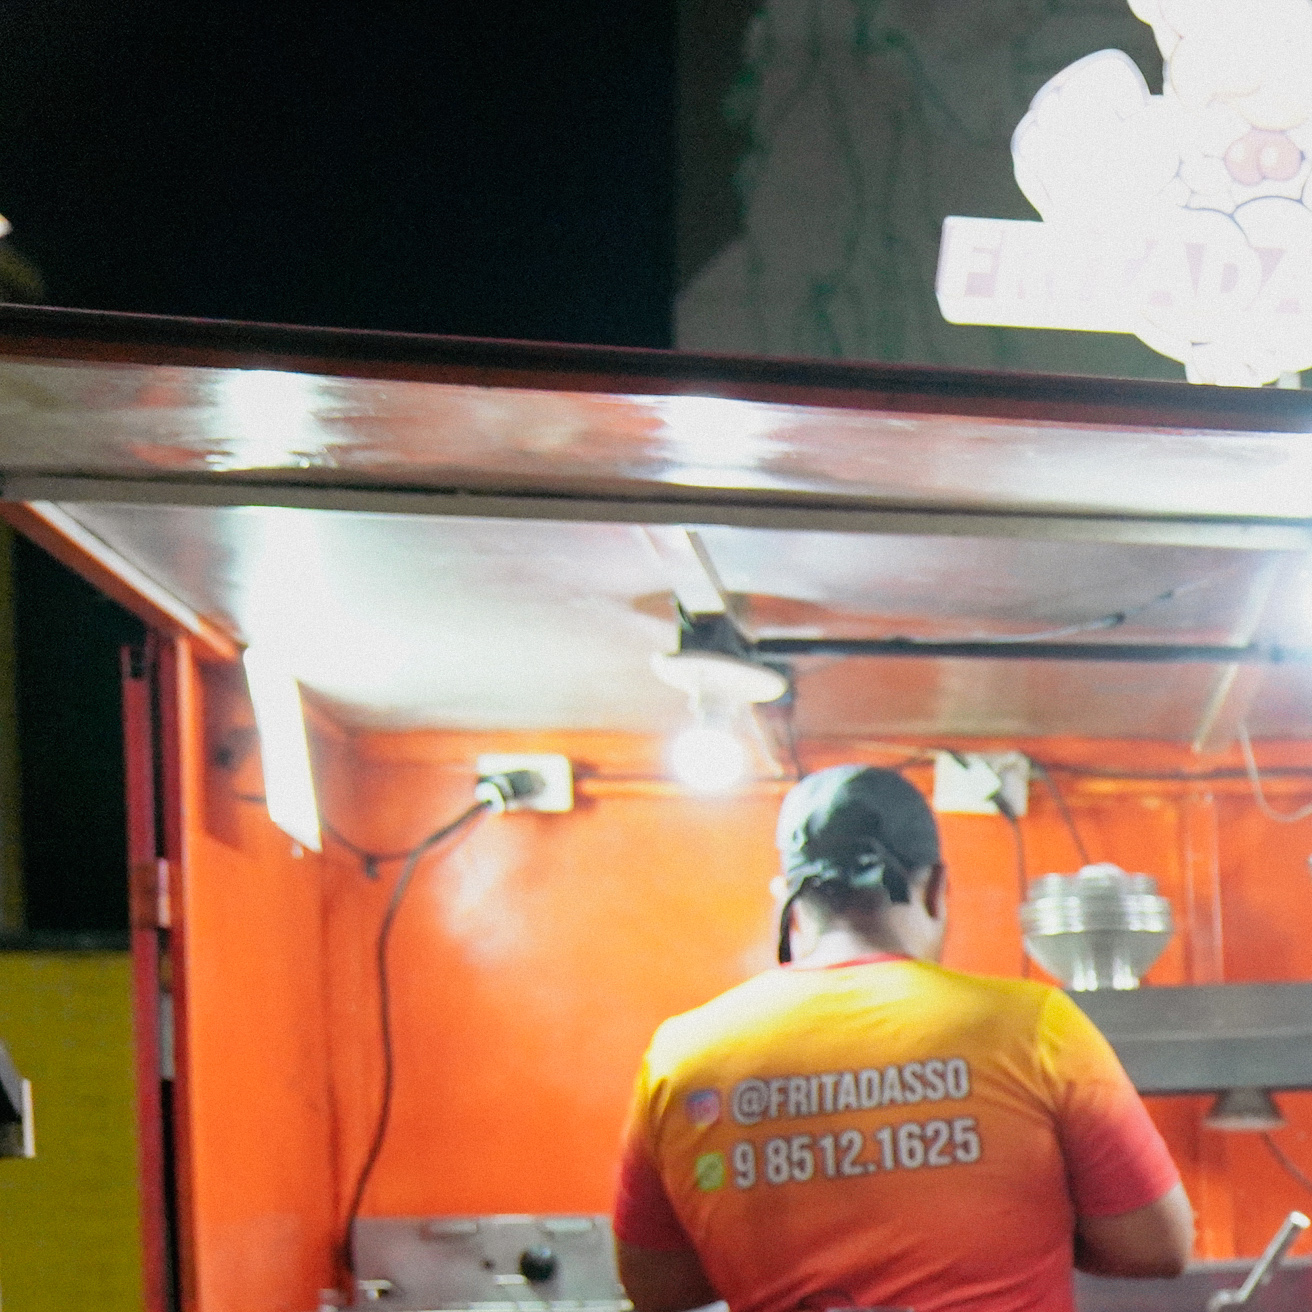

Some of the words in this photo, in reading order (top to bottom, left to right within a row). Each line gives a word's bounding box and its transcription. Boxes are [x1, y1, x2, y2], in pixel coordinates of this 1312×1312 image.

[731, 1057, 971, 1126] @FRITADASSO
[733, 1142, 756, 1189] 9
[766, 1118, 981, 1185] 8512.1625
